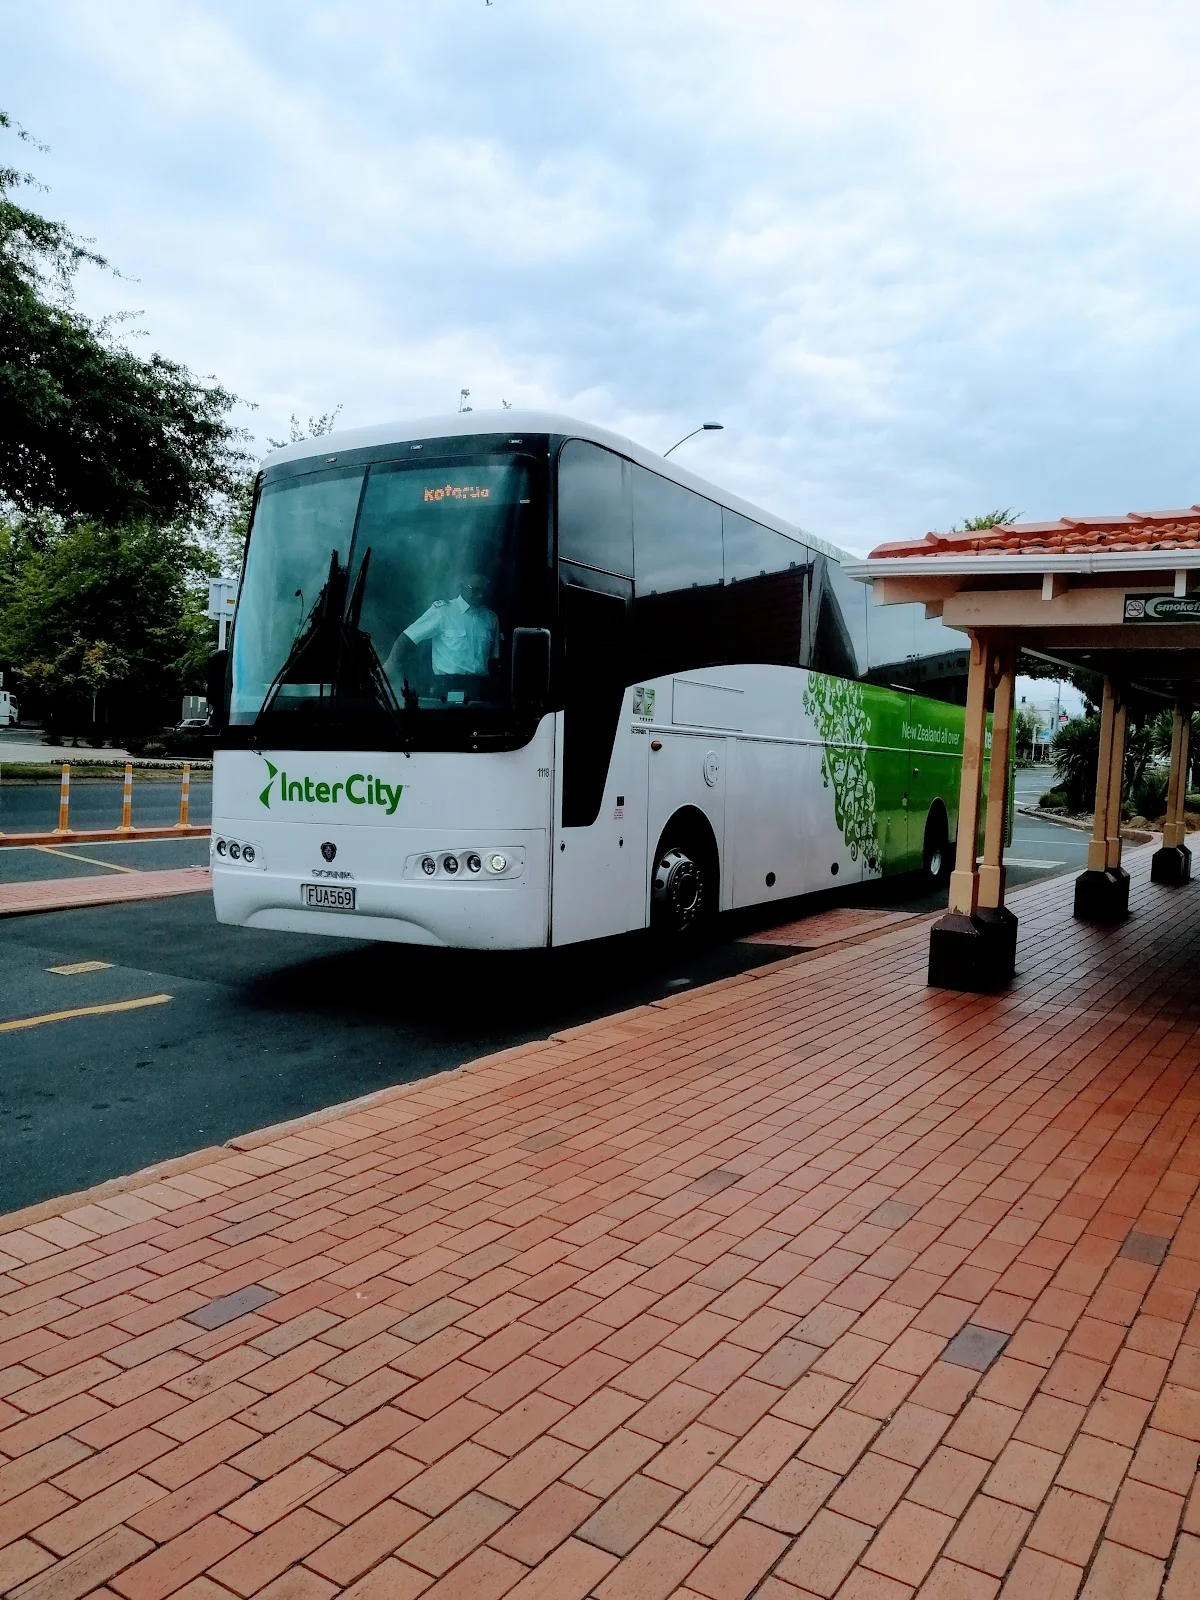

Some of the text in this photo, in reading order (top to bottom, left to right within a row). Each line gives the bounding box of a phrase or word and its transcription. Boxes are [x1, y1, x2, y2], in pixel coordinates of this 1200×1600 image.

[902, 721, 916, 739] New
[918, 724, 941, 743] Zealand
[948, 733, 960, 745] over
[537, 767, 550, 778] 1118
[281, 771, 404, 816] InterCity
[311, 869, 355, 880] SCANIA
[308, 888, 351, 906] FUA569
